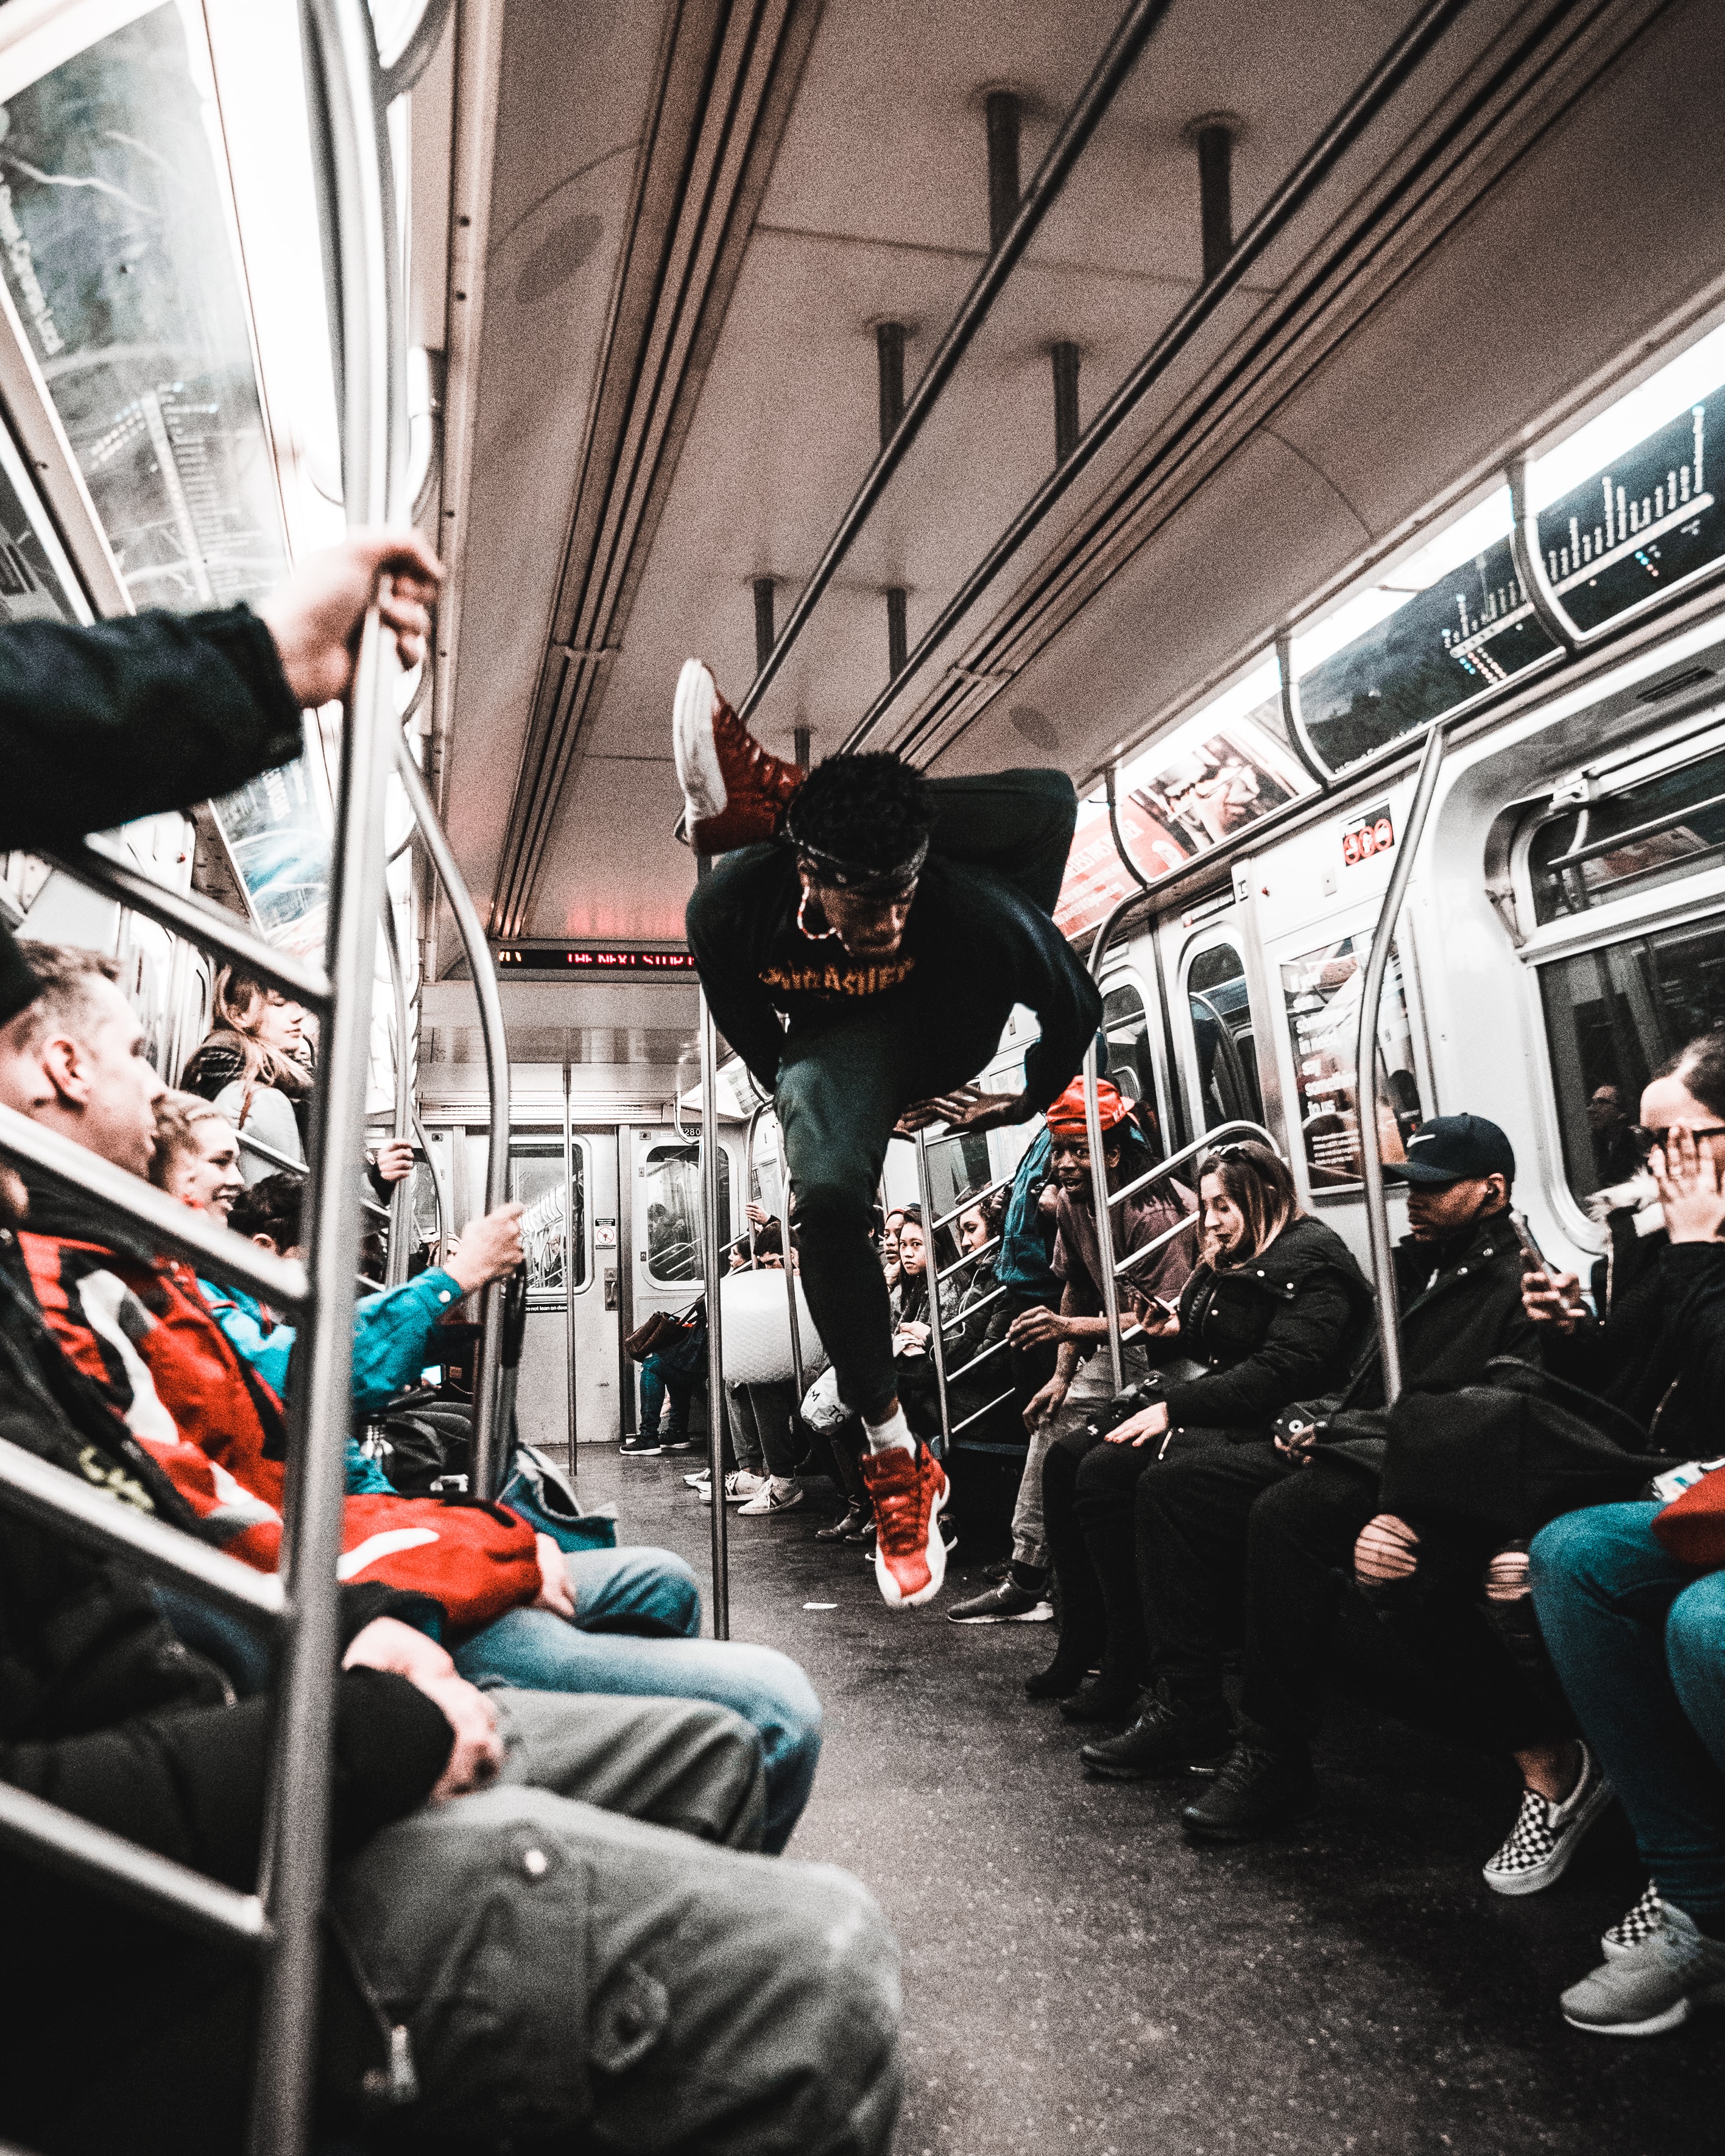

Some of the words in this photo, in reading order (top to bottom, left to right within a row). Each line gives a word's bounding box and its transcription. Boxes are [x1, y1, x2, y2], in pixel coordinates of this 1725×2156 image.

[1293, 995, 1314, 1008] see
[1302, 1059, 1322, 1077] say
[1307, 1101, 1321, 1116] to
[1321, 1099, 1336, 1115] us
